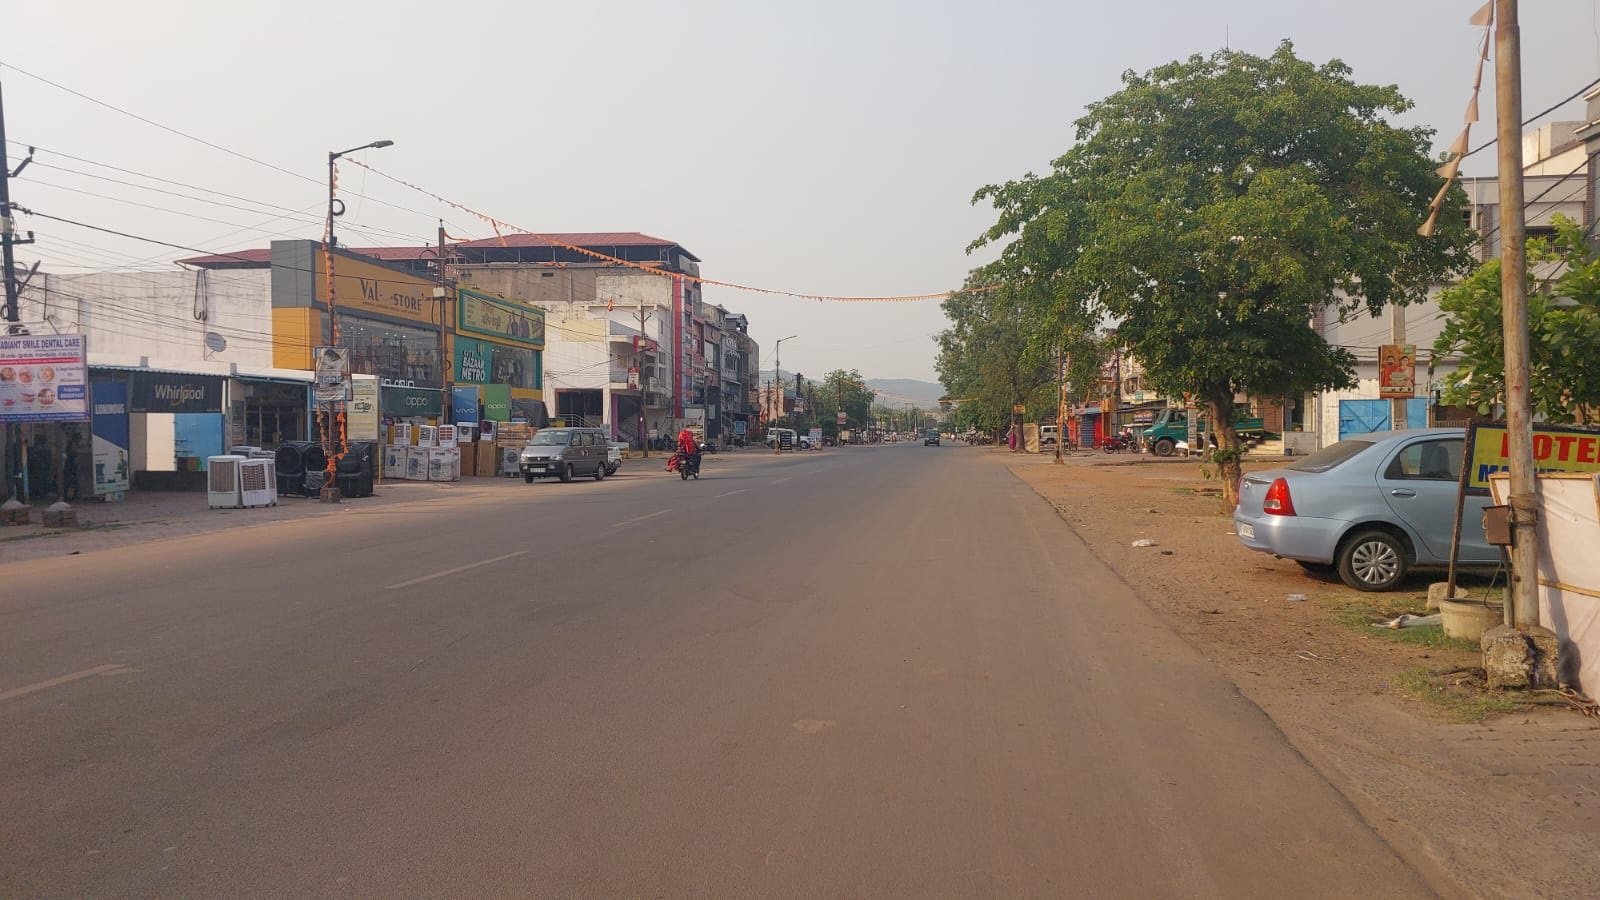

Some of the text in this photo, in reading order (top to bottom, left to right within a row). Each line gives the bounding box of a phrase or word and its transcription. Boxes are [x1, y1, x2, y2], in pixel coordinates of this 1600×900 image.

[0, 338, 80, 350] ADIANT SMILE DENTAL CARE
[461, 367, 486, 382] METRO
[155, 384, 205, 404] Whirlpool
